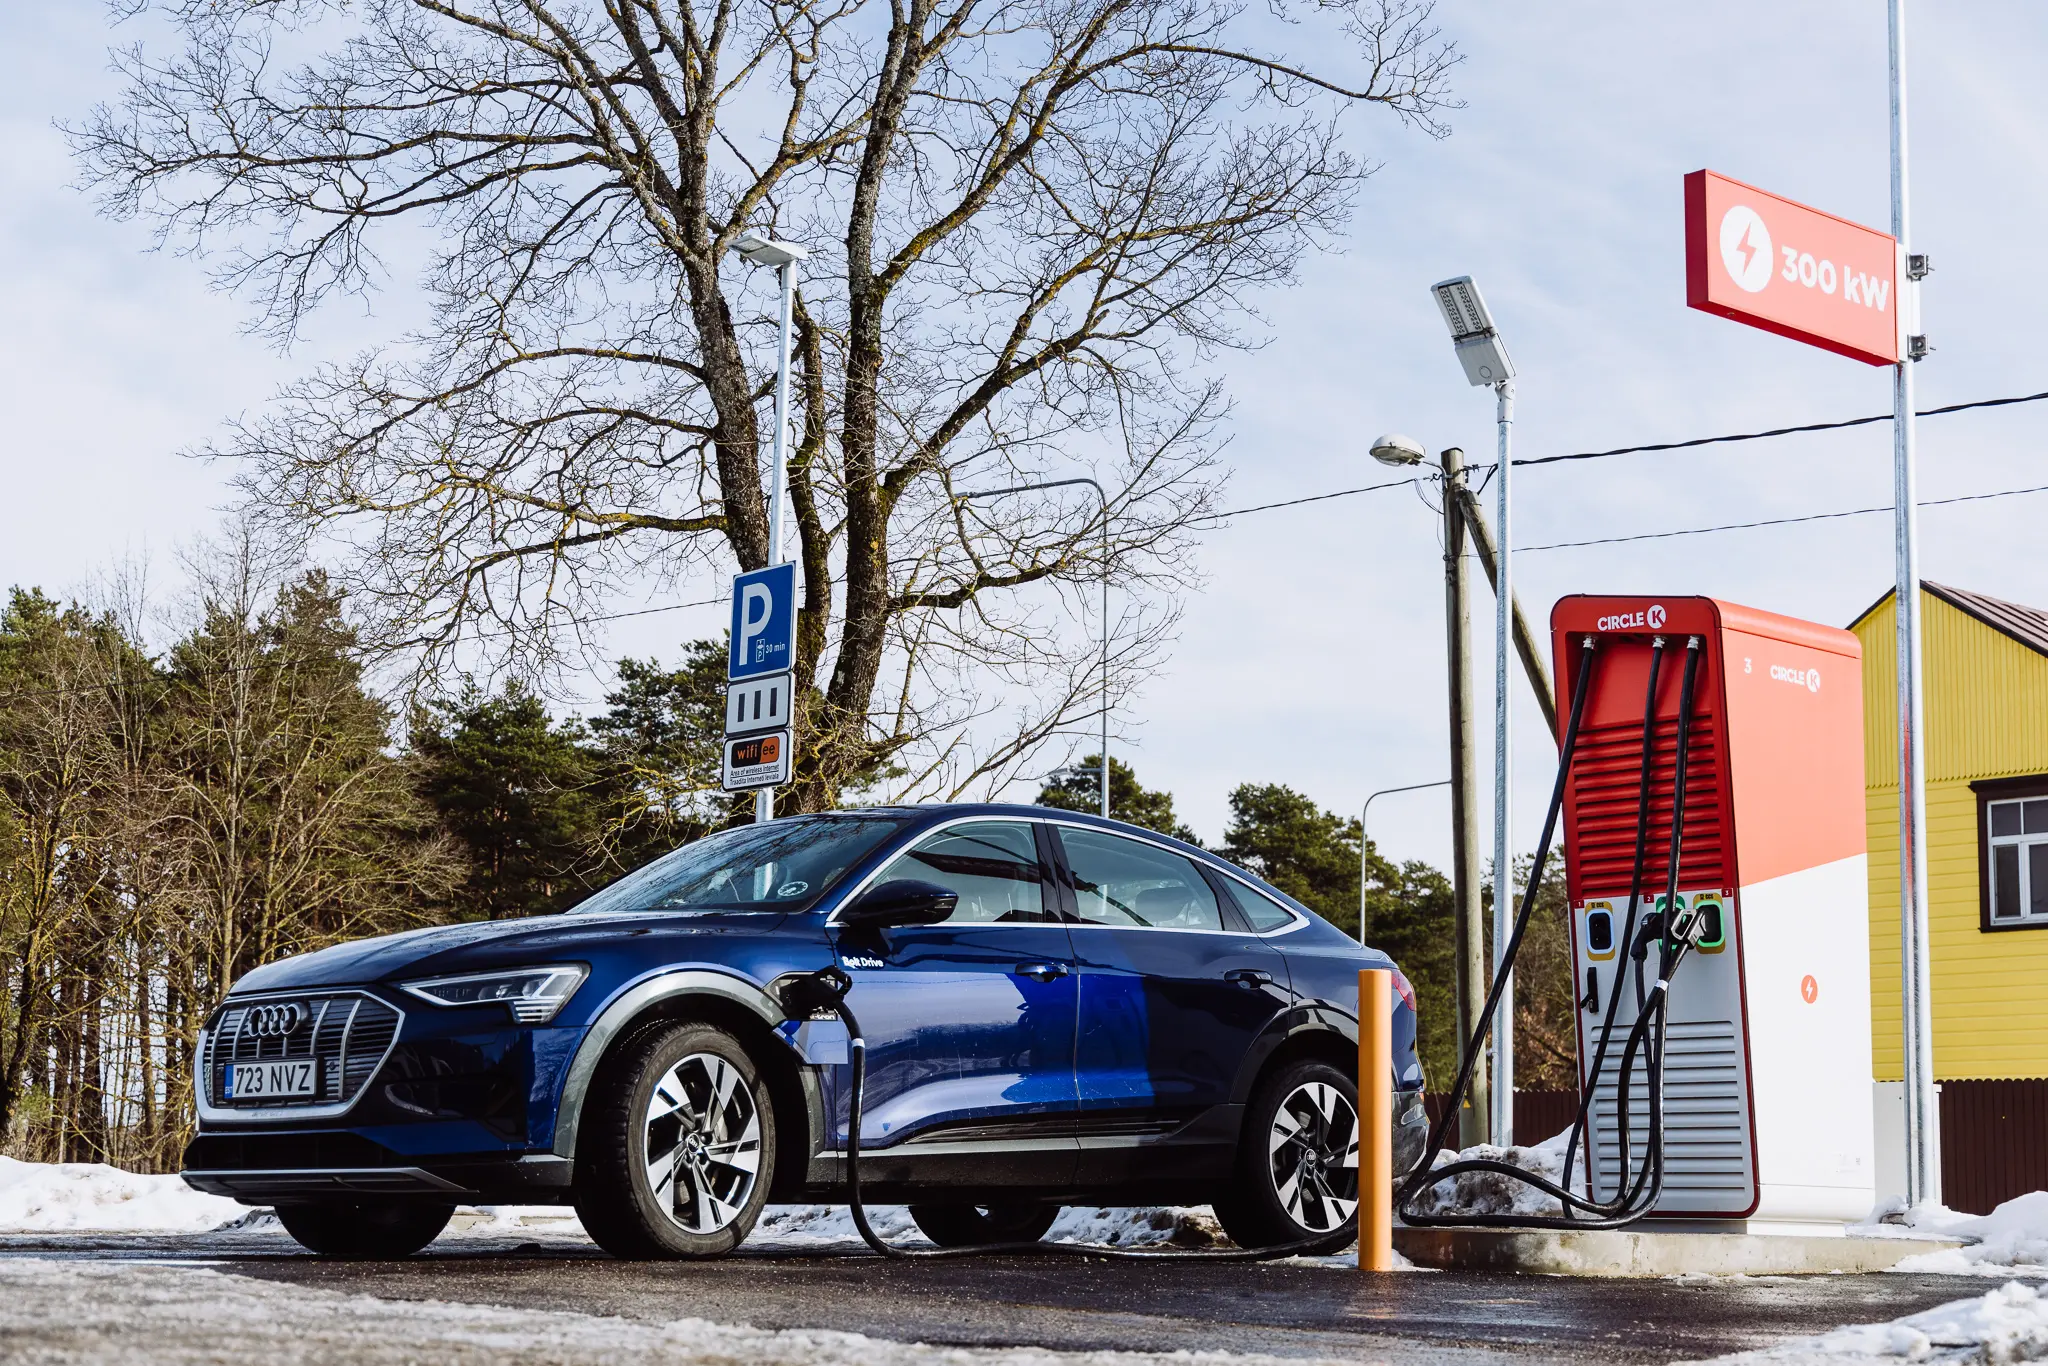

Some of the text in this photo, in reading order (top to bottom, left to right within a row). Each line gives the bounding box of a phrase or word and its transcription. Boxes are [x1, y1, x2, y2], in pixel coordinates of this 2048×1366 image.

[1781, 245, 1890, 312] 300 kW
[738, 582, 773, 666] P
[1597, 607, 1665, 631] CIRCLE K
[765, 641, 786, 654] 30 min
[1743, 657, 1752, 674] 3
[1769, 664, 1805, 686] CIRCLE
[737, 744, 776, 760] wifi ee
[860, 956, 884, 968] Drive
[235, 1064, 311, 1094] 723 NVZ
